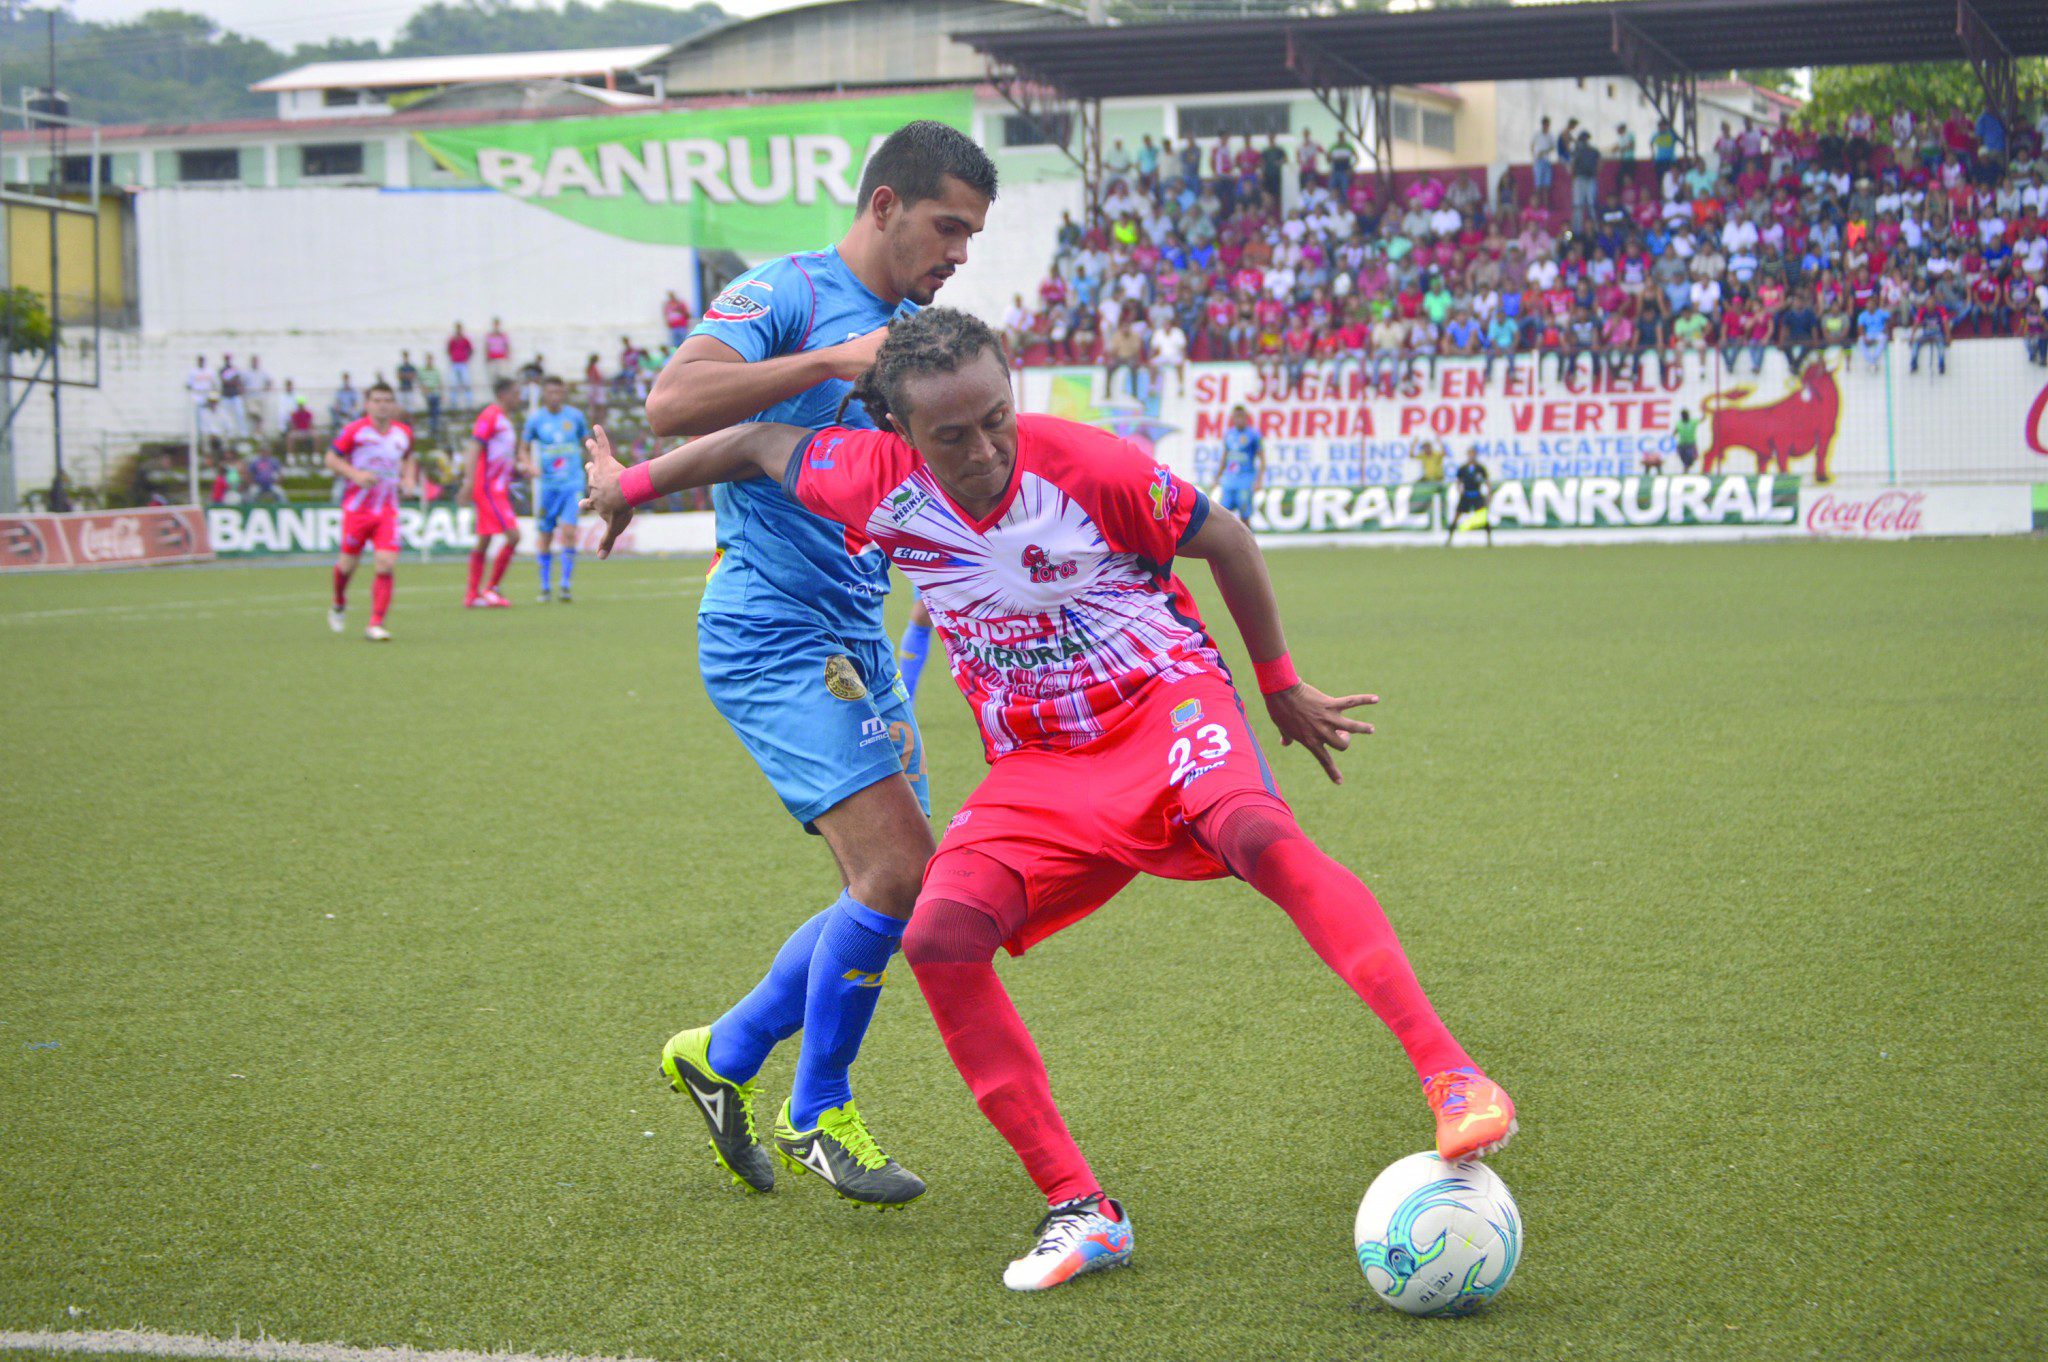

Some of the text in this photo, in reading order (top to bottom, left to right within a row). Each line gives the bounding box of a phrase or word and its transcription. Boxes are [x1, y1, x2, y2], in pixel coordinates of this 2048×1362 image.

[475, 133, 886, 207] BANRUR
[1195, 373, 1230, 404] SI
[1440, 367, 1487, 398] EN
[1399, 403, 1486, 435] POR
[1510, 400, 1673, 433] VERTE
[1267, 462, 1404, 485] POYAMOS
[891, 491, 928, 524] MERINSA
[1250, 483, 1429, 533] URAL
[206, 507, 477, 551] BANRRAL
[1167, 723, 1232, 787] 23
